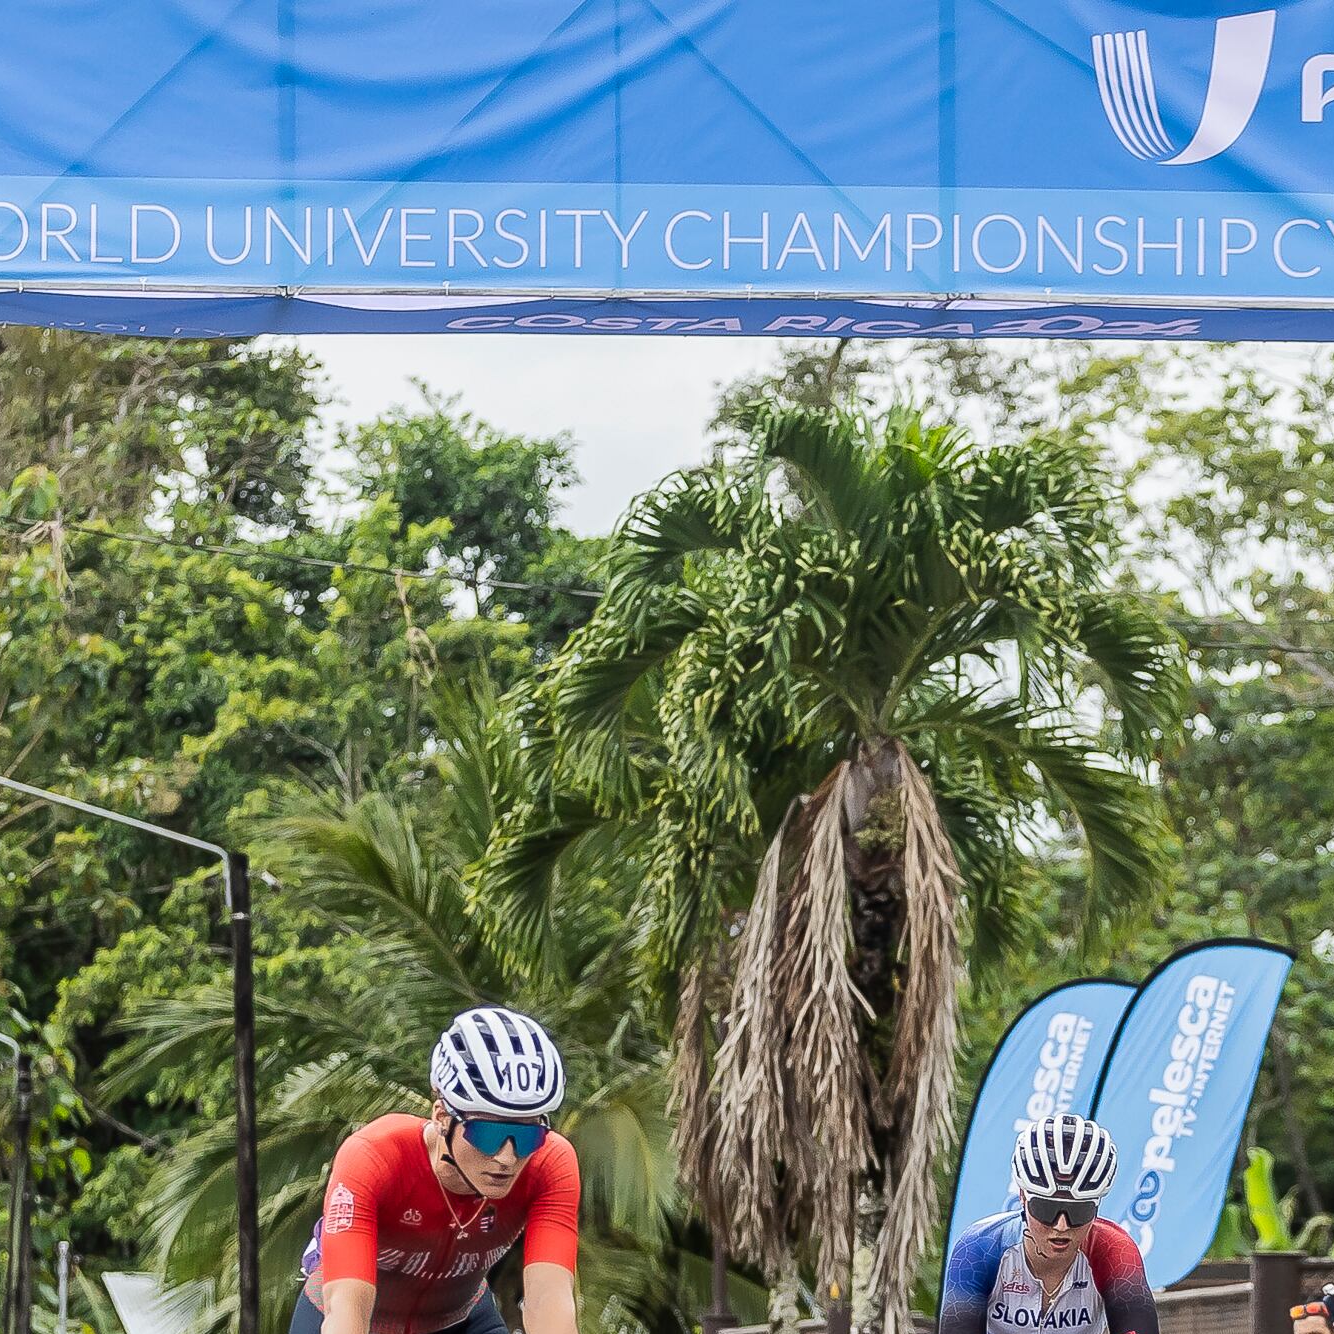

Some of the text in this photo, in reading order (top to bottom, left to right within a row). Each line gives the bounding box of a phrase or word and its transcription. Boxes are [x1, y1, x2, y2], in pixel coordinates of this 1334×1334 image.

[205, 205, 649, 270] UNIVERSITY
[665, 211, 1259, 277] CHAMPIONSHIP
[445, 313, 743, 332] COSTA
[762, 314, 975, 335] RICA
[502, 1062, 541, 1092] 107
[991, 1302, 1092, 1329] SLOVAKIA
